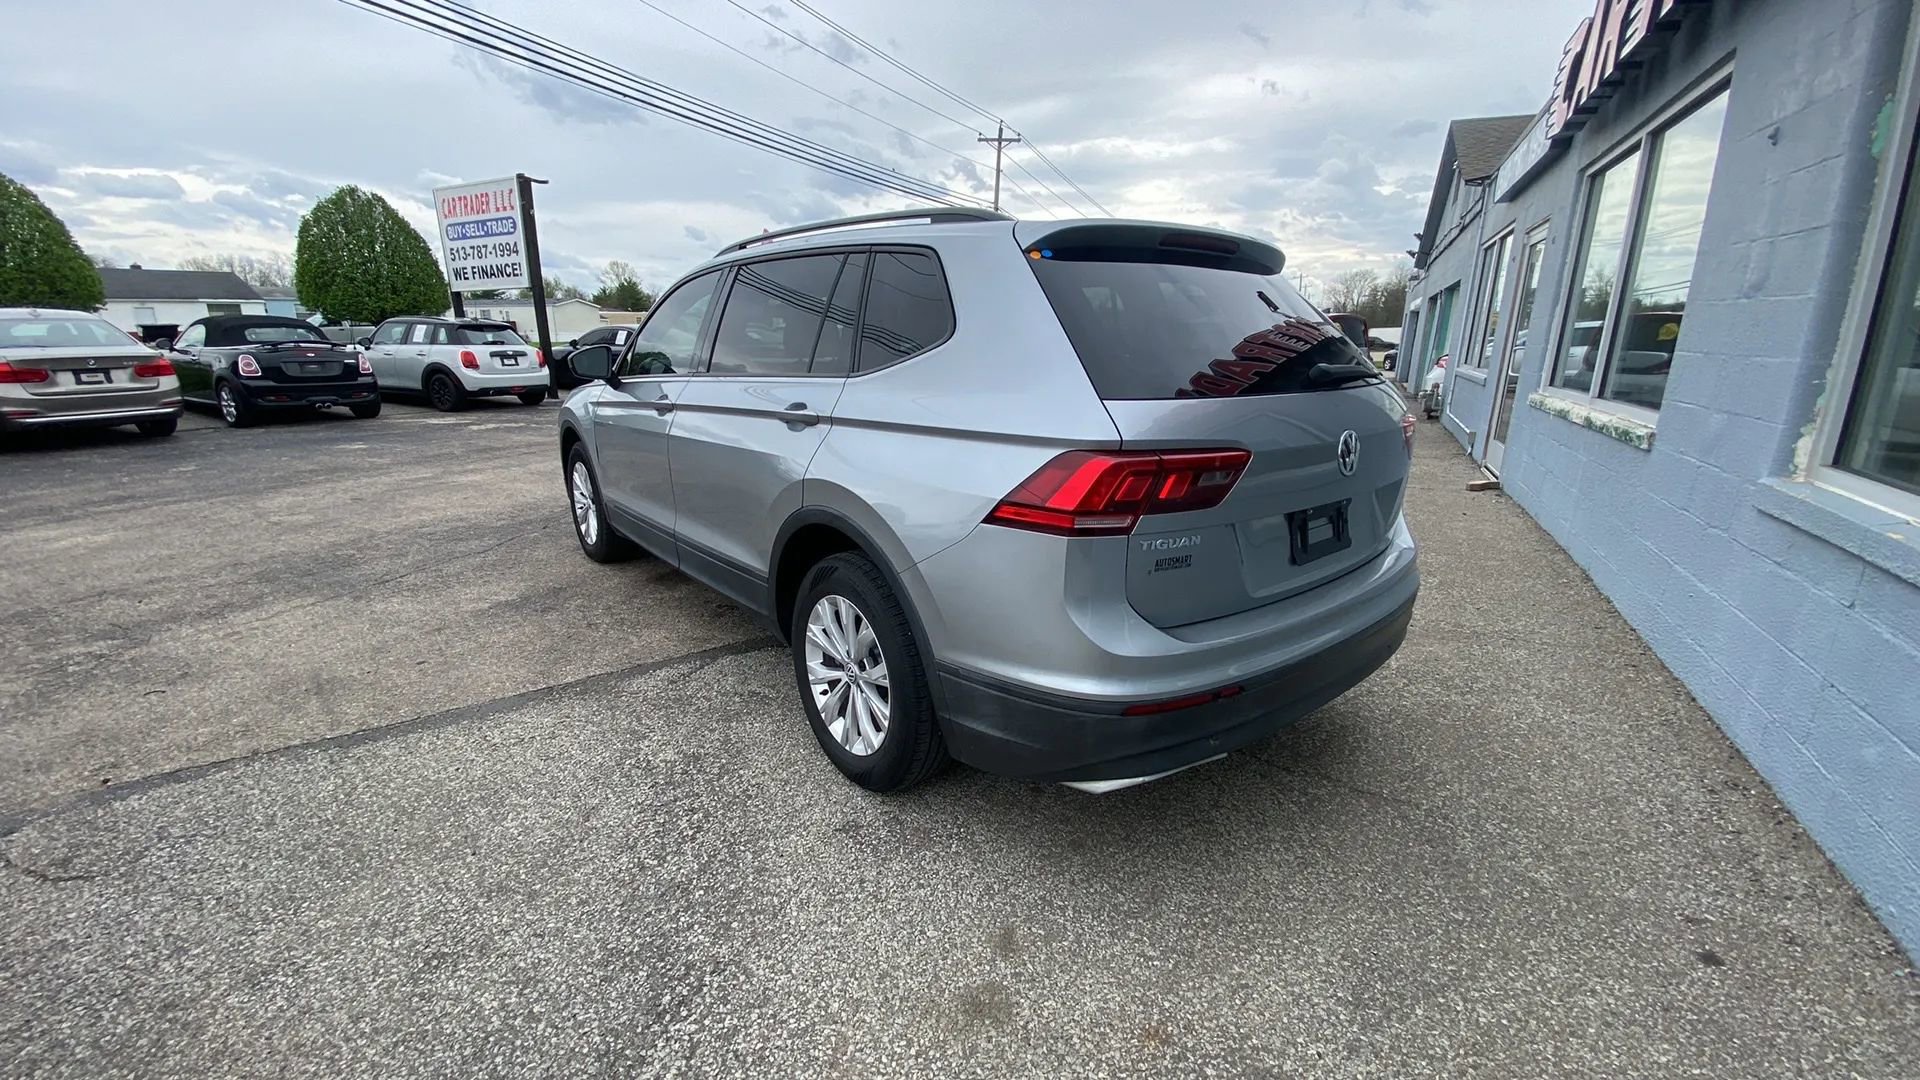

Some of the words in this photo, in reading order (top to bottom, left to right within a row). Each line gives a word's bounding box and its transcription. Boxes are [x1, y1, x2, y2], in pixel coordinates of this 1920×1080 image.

[441, 192, 491, 219] CARTRADER
[493, 188, 515, 213] LLC
[450, 241, 519, 262] 513-787-1994
[453, 266, 470, 281] WE
[472, 262, 523, 280] FINANCE!
[1139, 535, 1201, 551] TIGUAN
[1154, 554, 1193, 568] AUTOSMART
